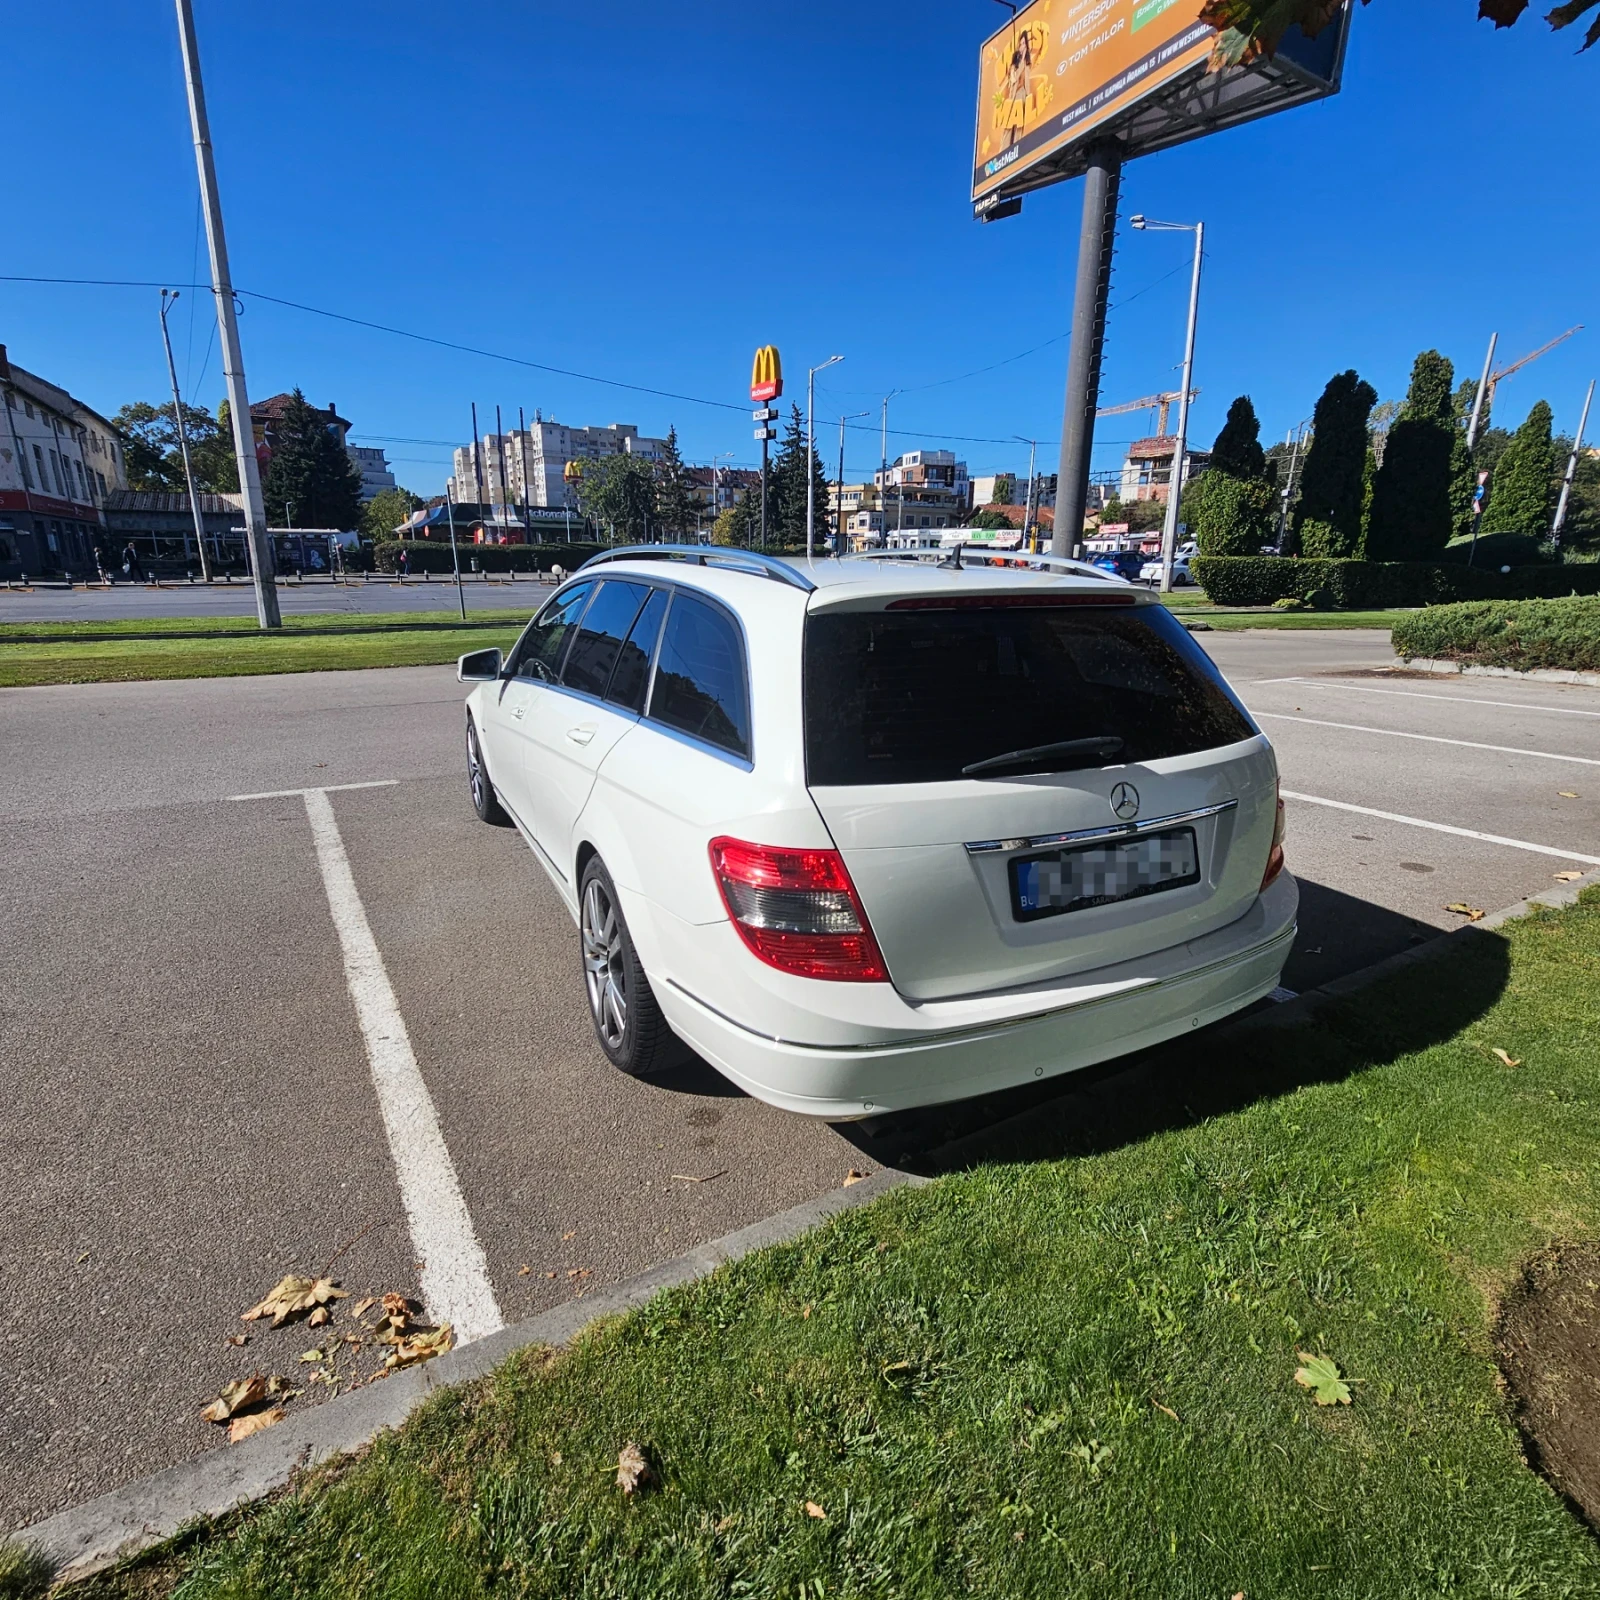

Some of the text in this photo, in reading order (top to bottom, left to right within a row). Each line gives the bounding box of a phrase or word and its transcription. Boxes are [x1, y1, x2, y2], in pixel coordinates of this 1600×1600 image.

[1069, 45, 1088, 66] TOM
[1089, 18, 1125, 51] TAILOR
[1062, 109, 1075, 126] WEST
[1075, 103, 1087, 117] MALL
[985, 144, 1019, 177] WestMall
